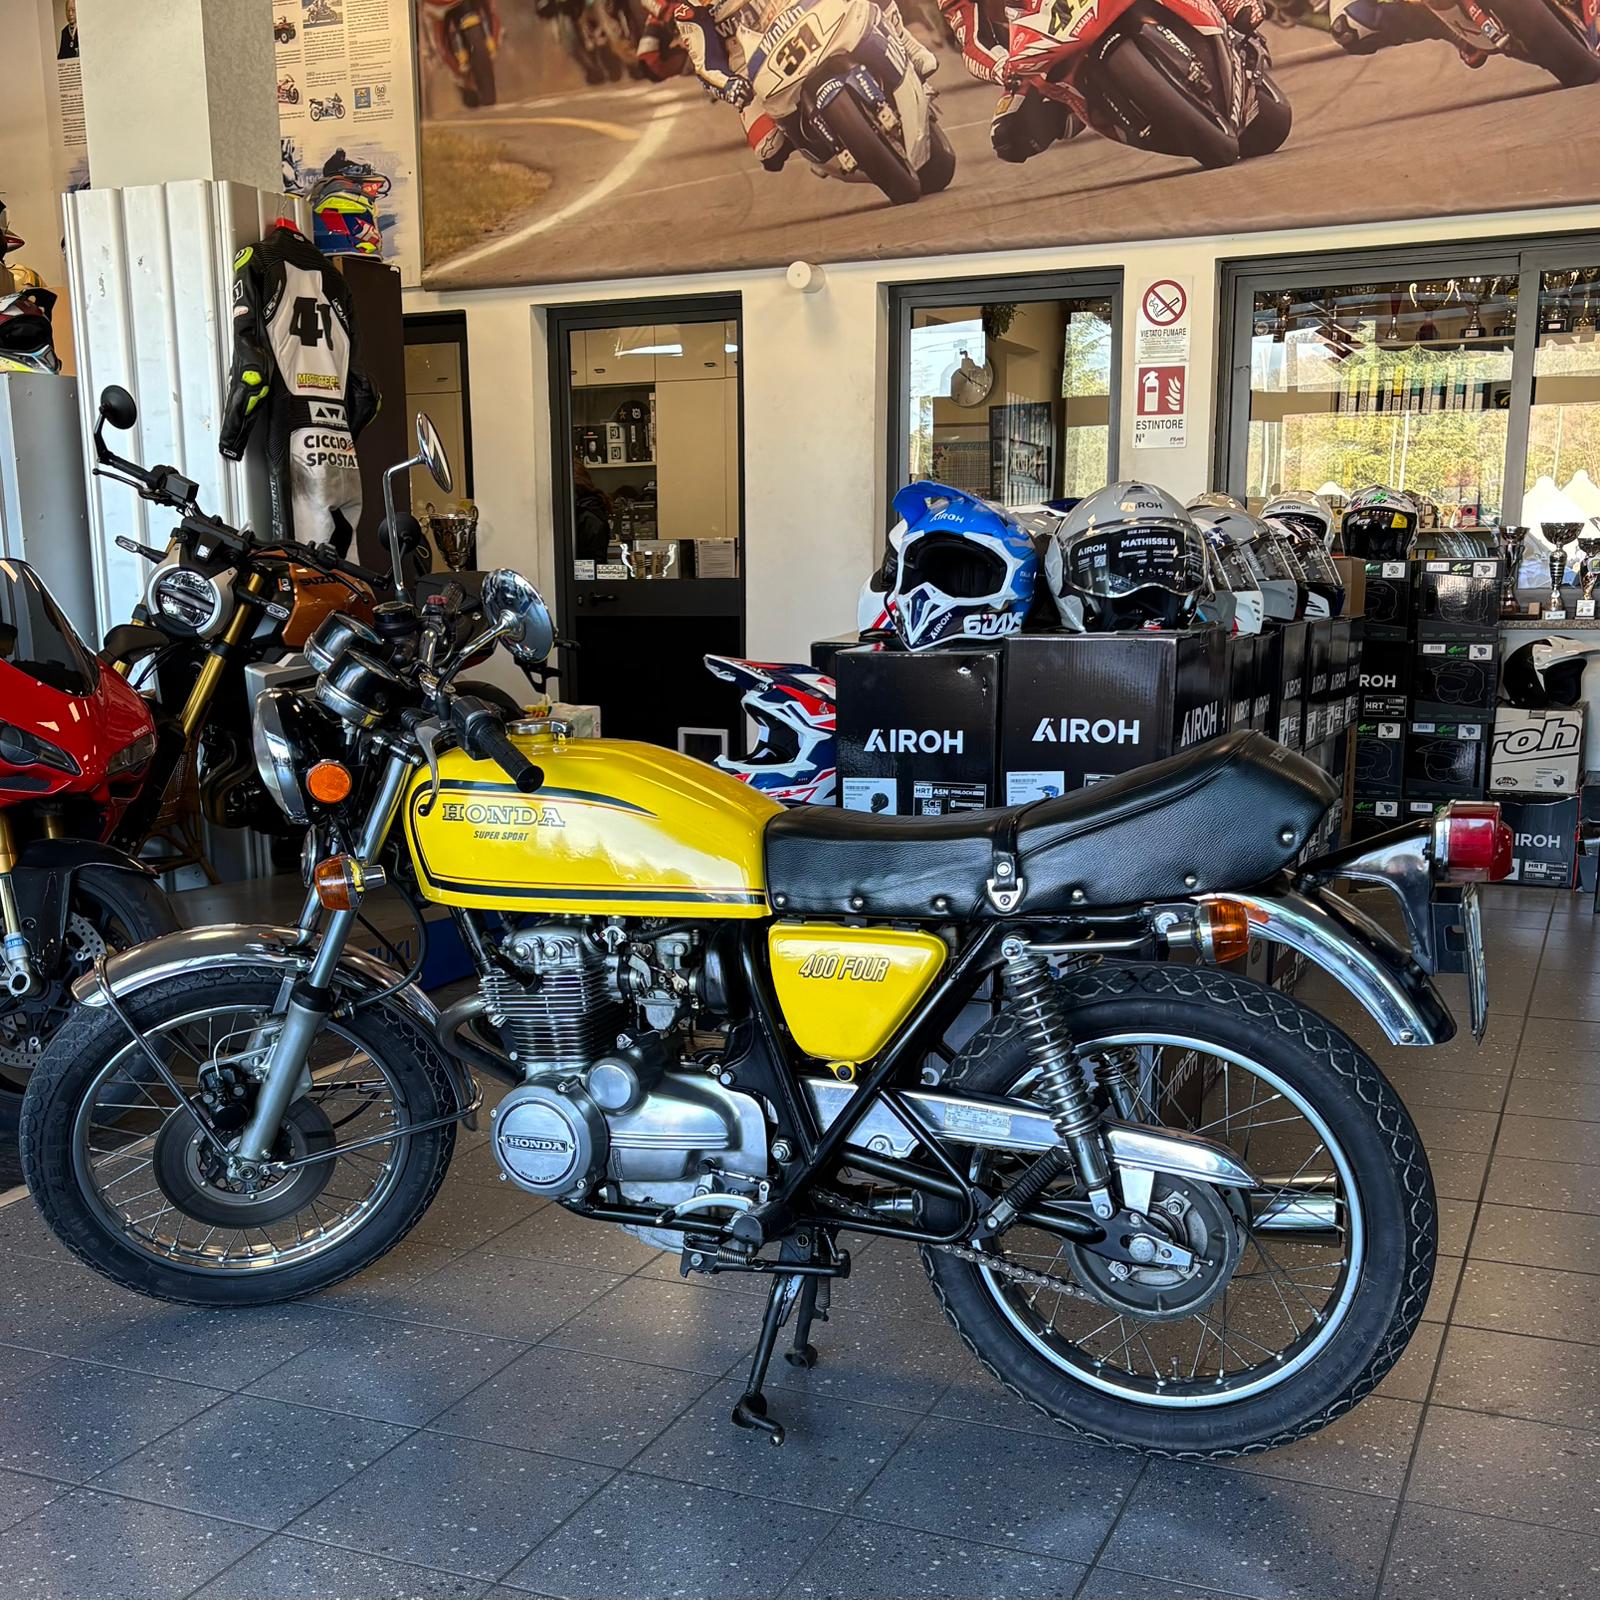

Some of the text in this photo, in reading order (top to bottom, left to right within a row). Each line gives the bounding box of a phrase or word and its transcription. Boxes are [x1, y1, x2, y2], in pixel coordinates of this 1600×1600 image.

[760, 5, 803, 54] WinWin
[1070, 11, 1094, 37] YAMAHA
[289, 296, 334, 351] 41
[1140, 327, 1187, 338] VIETATO FUMARE
[1135, 418, 1184, 431] ESTINTORE
[303, 434, 348, 450] CICCIO
[930, 509, 964, 524] AIROH
[1078, 543, 1107, 557] AIROH
[1120, 537, 1168, 548] MATHISSE
[929, 611, 953, 639] AIROH
[1330, 671, 1347, 691] AIROH
[1359, 674, 1397, 688] ROH
[1032, 717, 1140, 745] AIROH
[1181, 700, 1218, 748] AIROH
[864, 728, 964, 754] AIROH
[915, 786, 931, 794] HRT
[933, 788, 949, 796] ASN
[922, 800, 941, 808] ECE
[442, 803, 565, 828] HONDA
[473, 830, 529, 842] SUPER SPORT
[1515, 832, 1561, 849] IROH
[798, 953, 891, 983] 400 FOUR
[508, 1137, 564, 1151] HONDA
